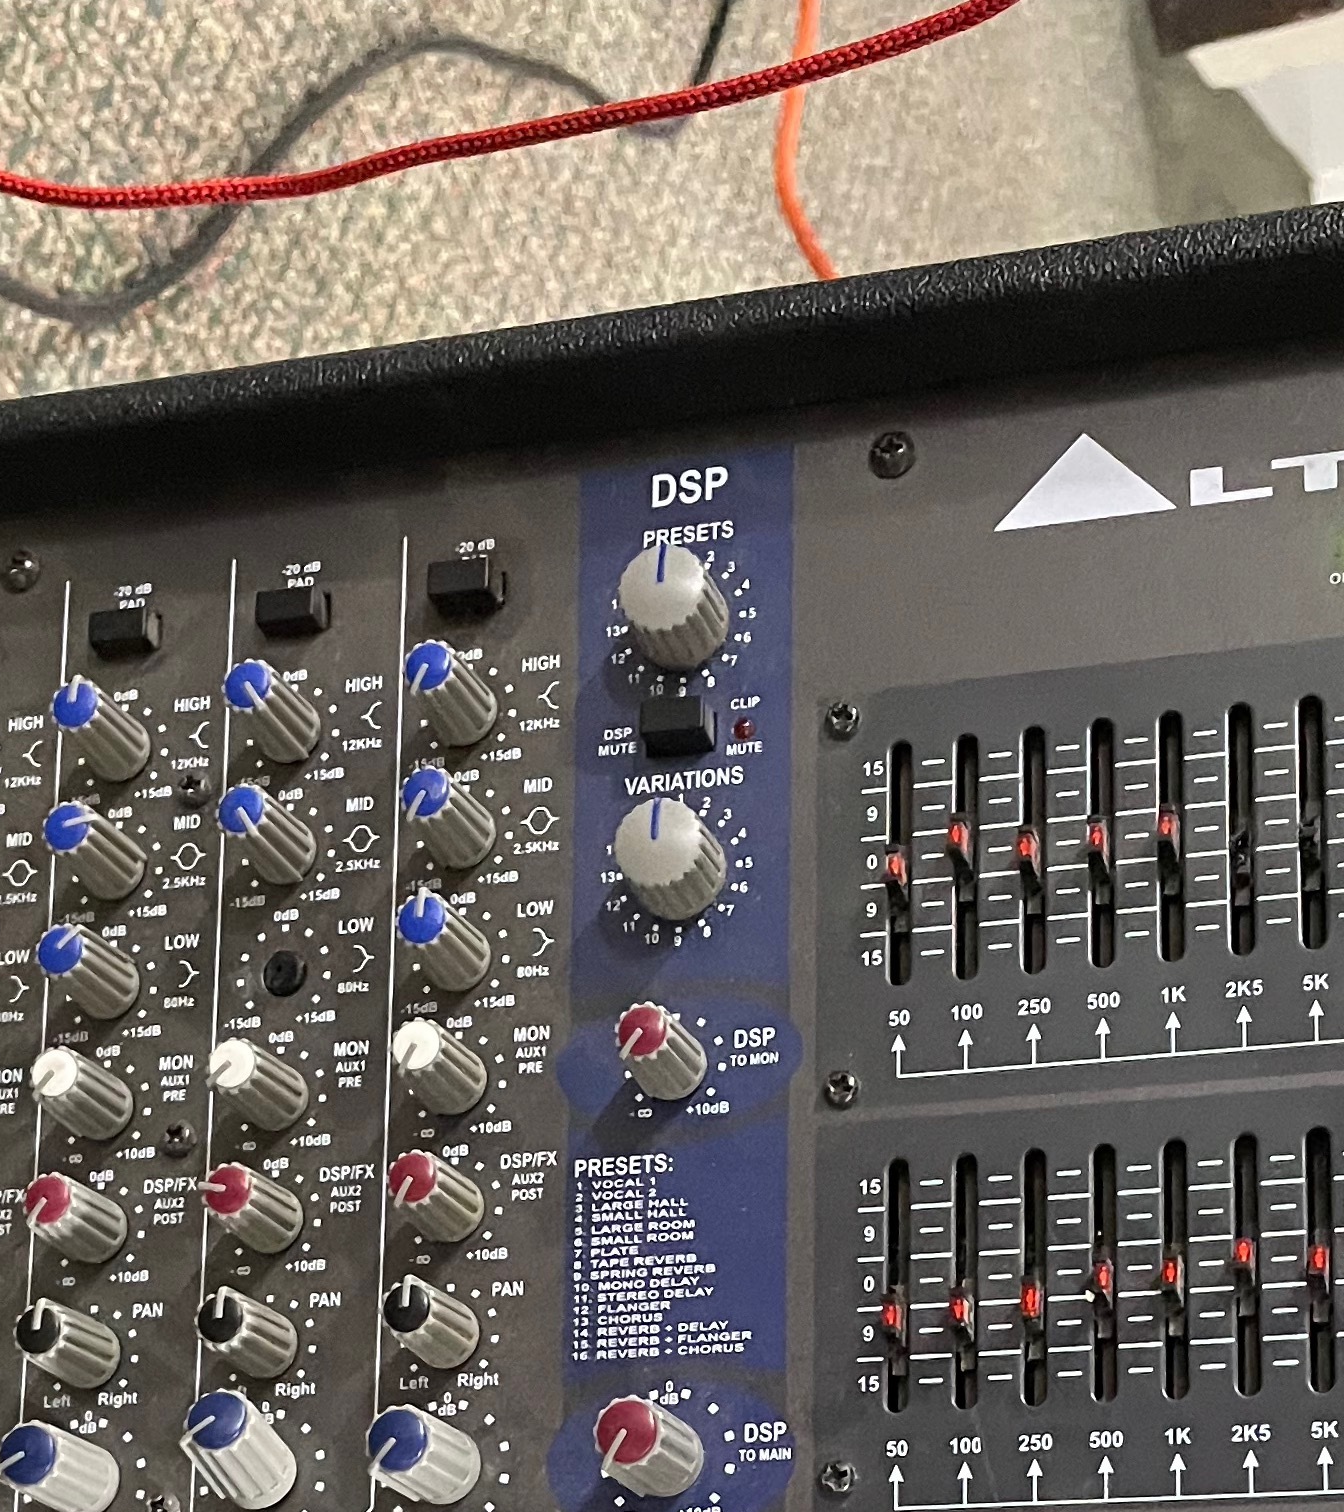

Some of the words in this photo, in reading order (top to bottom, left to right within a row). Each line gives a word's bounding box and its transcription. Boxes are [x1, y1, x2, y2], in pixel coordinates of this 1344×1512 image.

[652, 467, 728, 507] DSP
[644, 521, 734, 548] PRESETS
[522, 655, 560, 672] HIGH
[731, 696, 760, 710] CLIP
[604, 727, 632, 740] DSP
[598, 742, 636, 756] MUTE
[726, 741, 762, 755] MUTE
[524, 777, 552, 793] MID
[625, 766, 743, 795] VARIATIONS
[517, 900, 553, 917] LOW
[889, 1010, 910, 1026] 50
[951, 1004, 982, 1020] 100
[1018, 998, 1051, 1015] 250
[1088, 992, 1120, 1009] 500
[1161, 986, 1186, 1003] 1K
[1226, 979, 1263, 998] 2K5
[1303, 974, 1329, 991] 5K
[514, 1026, 550, 1042] MON
[734, 1027, 775, 1048] DSP
[516, 1046, 546, 1058] AUX1
[730, 1055, 747, 1066] TO
[750, 1052, 779, 1065] MON
[519, 1061, 543, 1074] PRE
[501, 1151, 557, 1169] DSP/FX
[575, 1154, 673, 1178] PRESETS:
[512, 1172, 544, 1185] AUX2
[512, 1188, 543, 1201] POST
[591, 1246, 638, 1257] PLATE
[492, 1281, 523, 1296] PAN
[598, 1280, 645, 1290] MONO
[650, 1276, 699, 1288] DELAY
[598, 1290, 659, 1302] STEREO
[664, 1287, 714, 1298] DELAY
[598, 1301, 670, 1313] FLANGER
[598, 1313, 662, 1325] CHORUS
[458, 1372, 498, 1389] Right
[744, 1422, 786, 1443] DSP
[887, 1440, 908, 1457] 50
[950, 1437, 981, 1454] 100
[1019, 1434, 1052, 1451] 250
[1090, 1431, 1123, 1448] 500
[1165, 1427, 1191, 1444] 1K
[1232, 1424, 1271, 1442] 2K5
[1311, 1421, 1338, 1438] 5K
[739, 1449, 756, 1461] TO
[759, 1448, 791, 1460] MAIN
